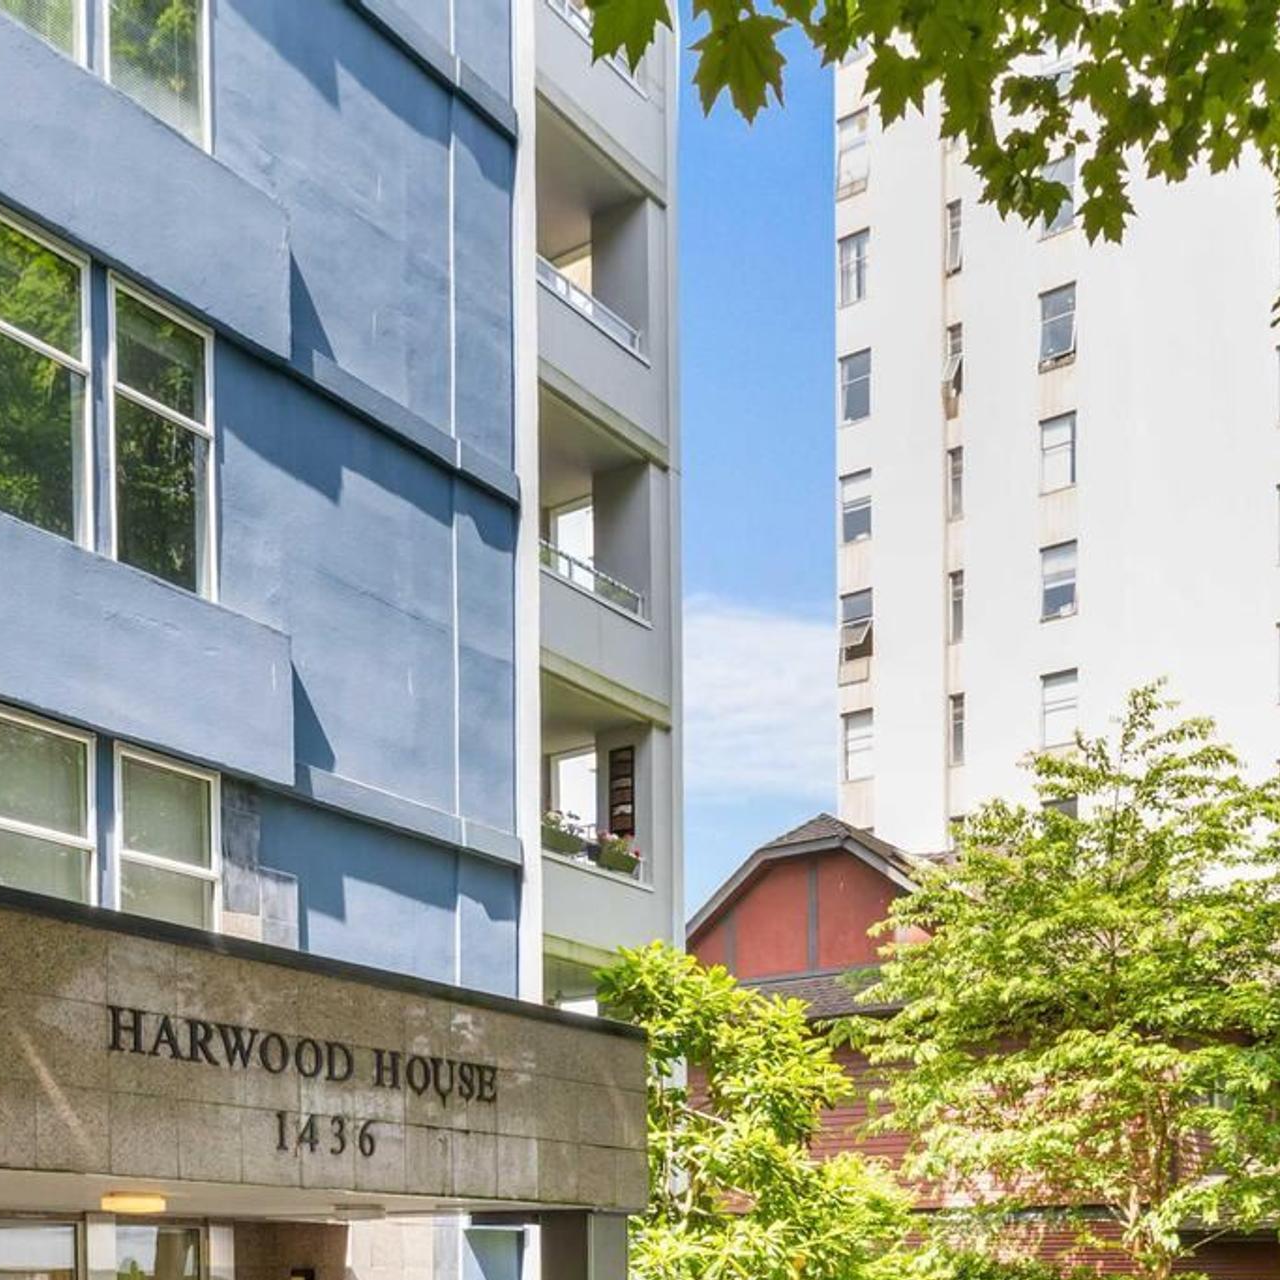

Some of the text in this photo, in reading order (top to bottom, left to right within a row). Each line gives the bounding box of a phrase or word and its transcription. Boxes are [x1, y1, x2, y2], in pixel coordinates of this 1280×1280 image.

[107, 1005, 498, 1104] HARWOOD HOUSE
[275, 1110, 376, 1157] 1436
